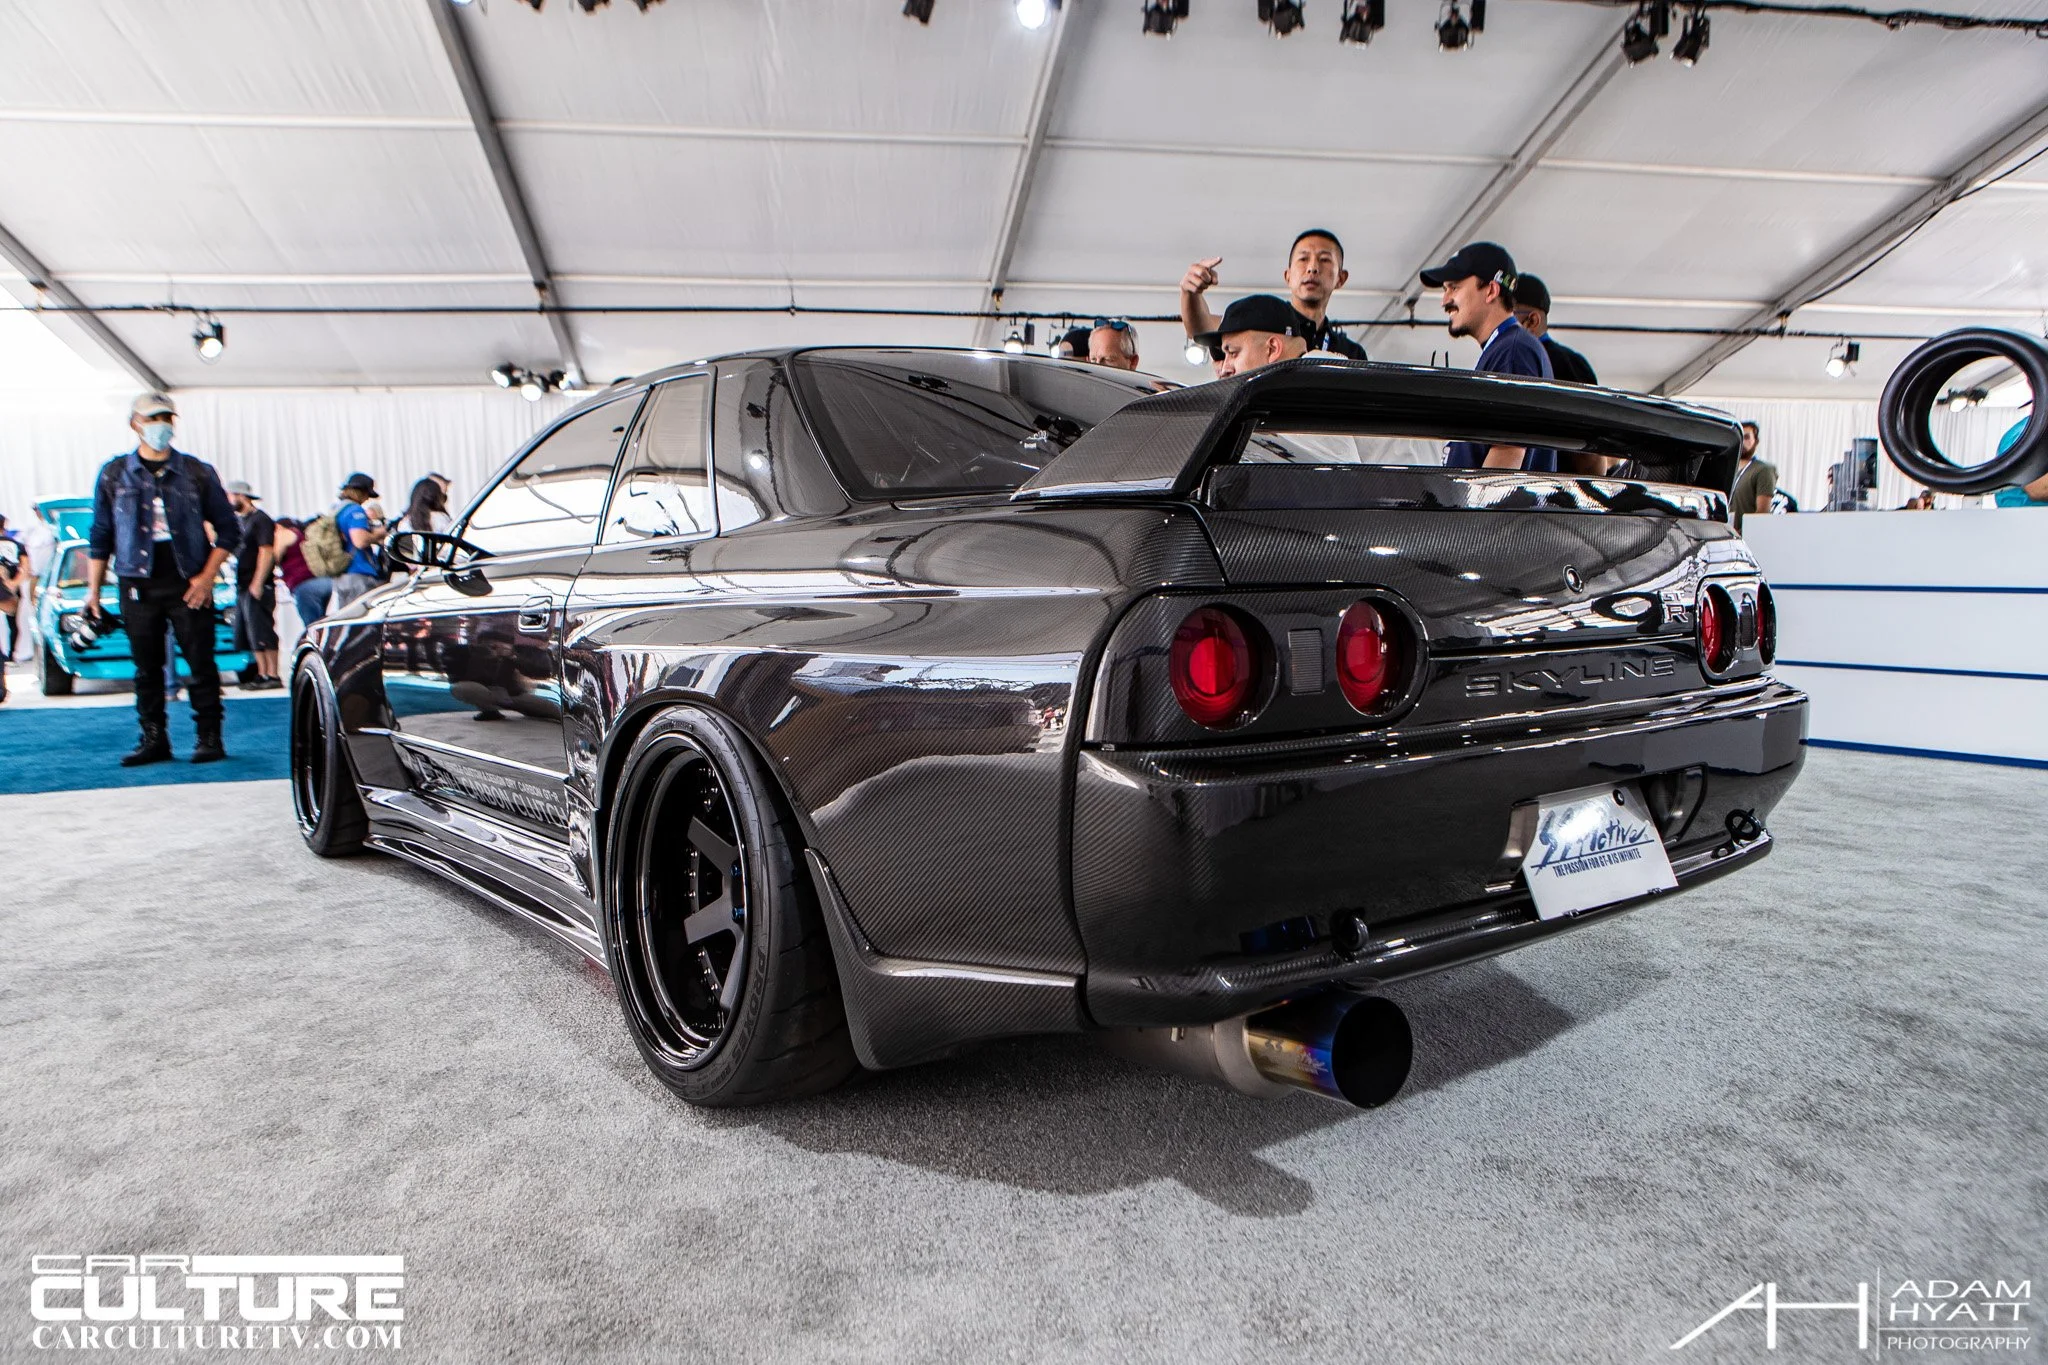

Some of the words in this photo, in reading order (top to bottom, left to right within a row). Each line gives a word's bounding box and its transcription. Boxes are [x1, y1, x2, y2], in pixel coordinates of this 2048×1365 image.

[1465, 655, 1676, 698] SKYLINE
[462, 777, 515, 813] CARBON
[512, 792, 569, 829] CLUTCH
[518, 781, 544, 799] CARBON
[542, 787, 560, 803] GT-R
[1552, 865, 1566, 878] THE
[1564, 860, 1590, 876] PASSION
[1588, 856, 1600, 870] FOR
[1617, 847, 1642, 863] INFINITE
